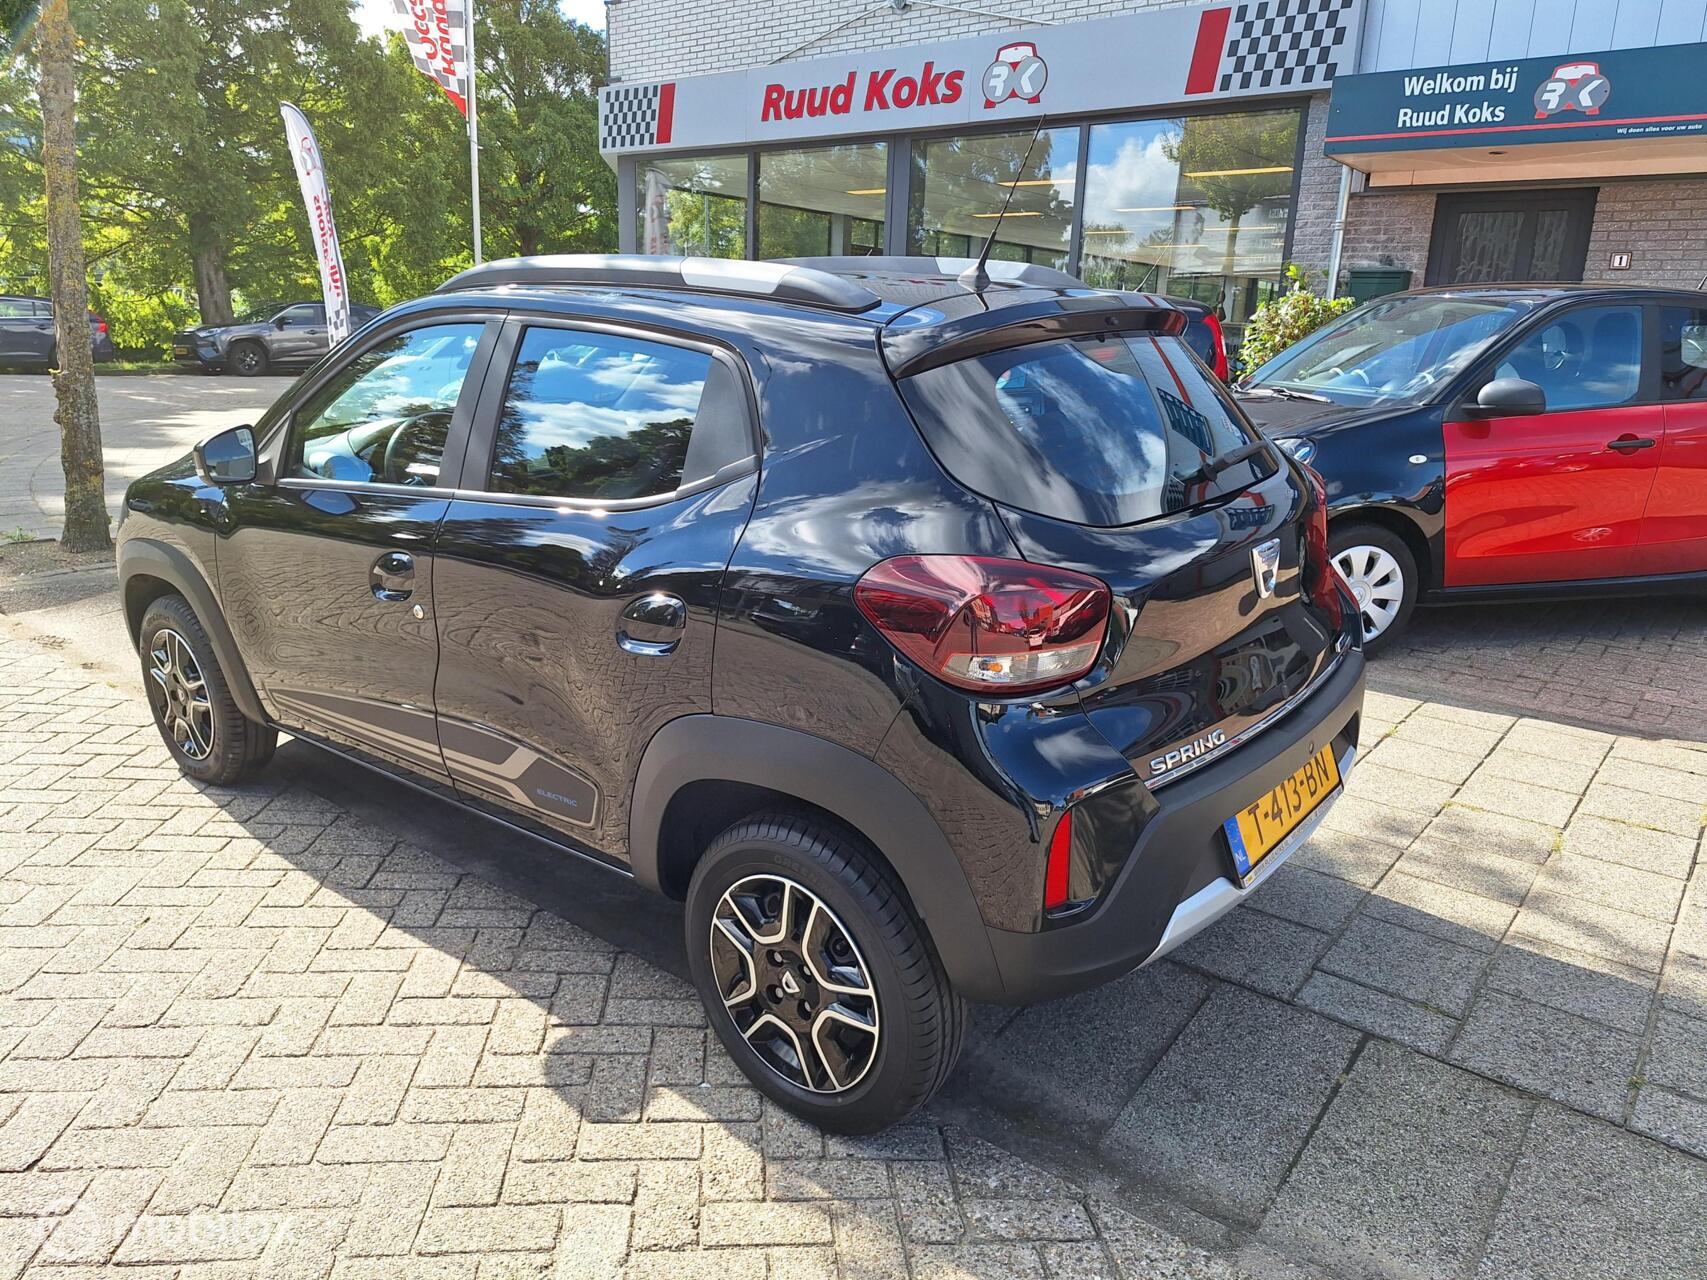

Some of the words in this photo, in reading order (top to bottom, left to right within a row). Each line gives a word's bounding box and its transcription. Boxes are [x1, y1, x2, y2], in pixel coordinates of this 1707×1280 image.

[761, 71, 857, 122] Ruud
[863, 61, 966, 111] Koks
[1403, 69, 1485, 97] Welkom
[1489, 66, 1520, 95] bij
[1397, 105, 1449, 128] Ruud
[1453, 101, 1506, 125] Koks
[1616, 127, 1628, 135] Wij
[1645, 125, 1660, 133] alles
[1618, 255, 1624, 266] 1
[1149, 728, 1226, 775] SPRING
[536, 788, 578, 807] ELECTRIC
[1248, 750, 1330, 846] T-413-BN
[1234, 850, 1247, 865] NL
